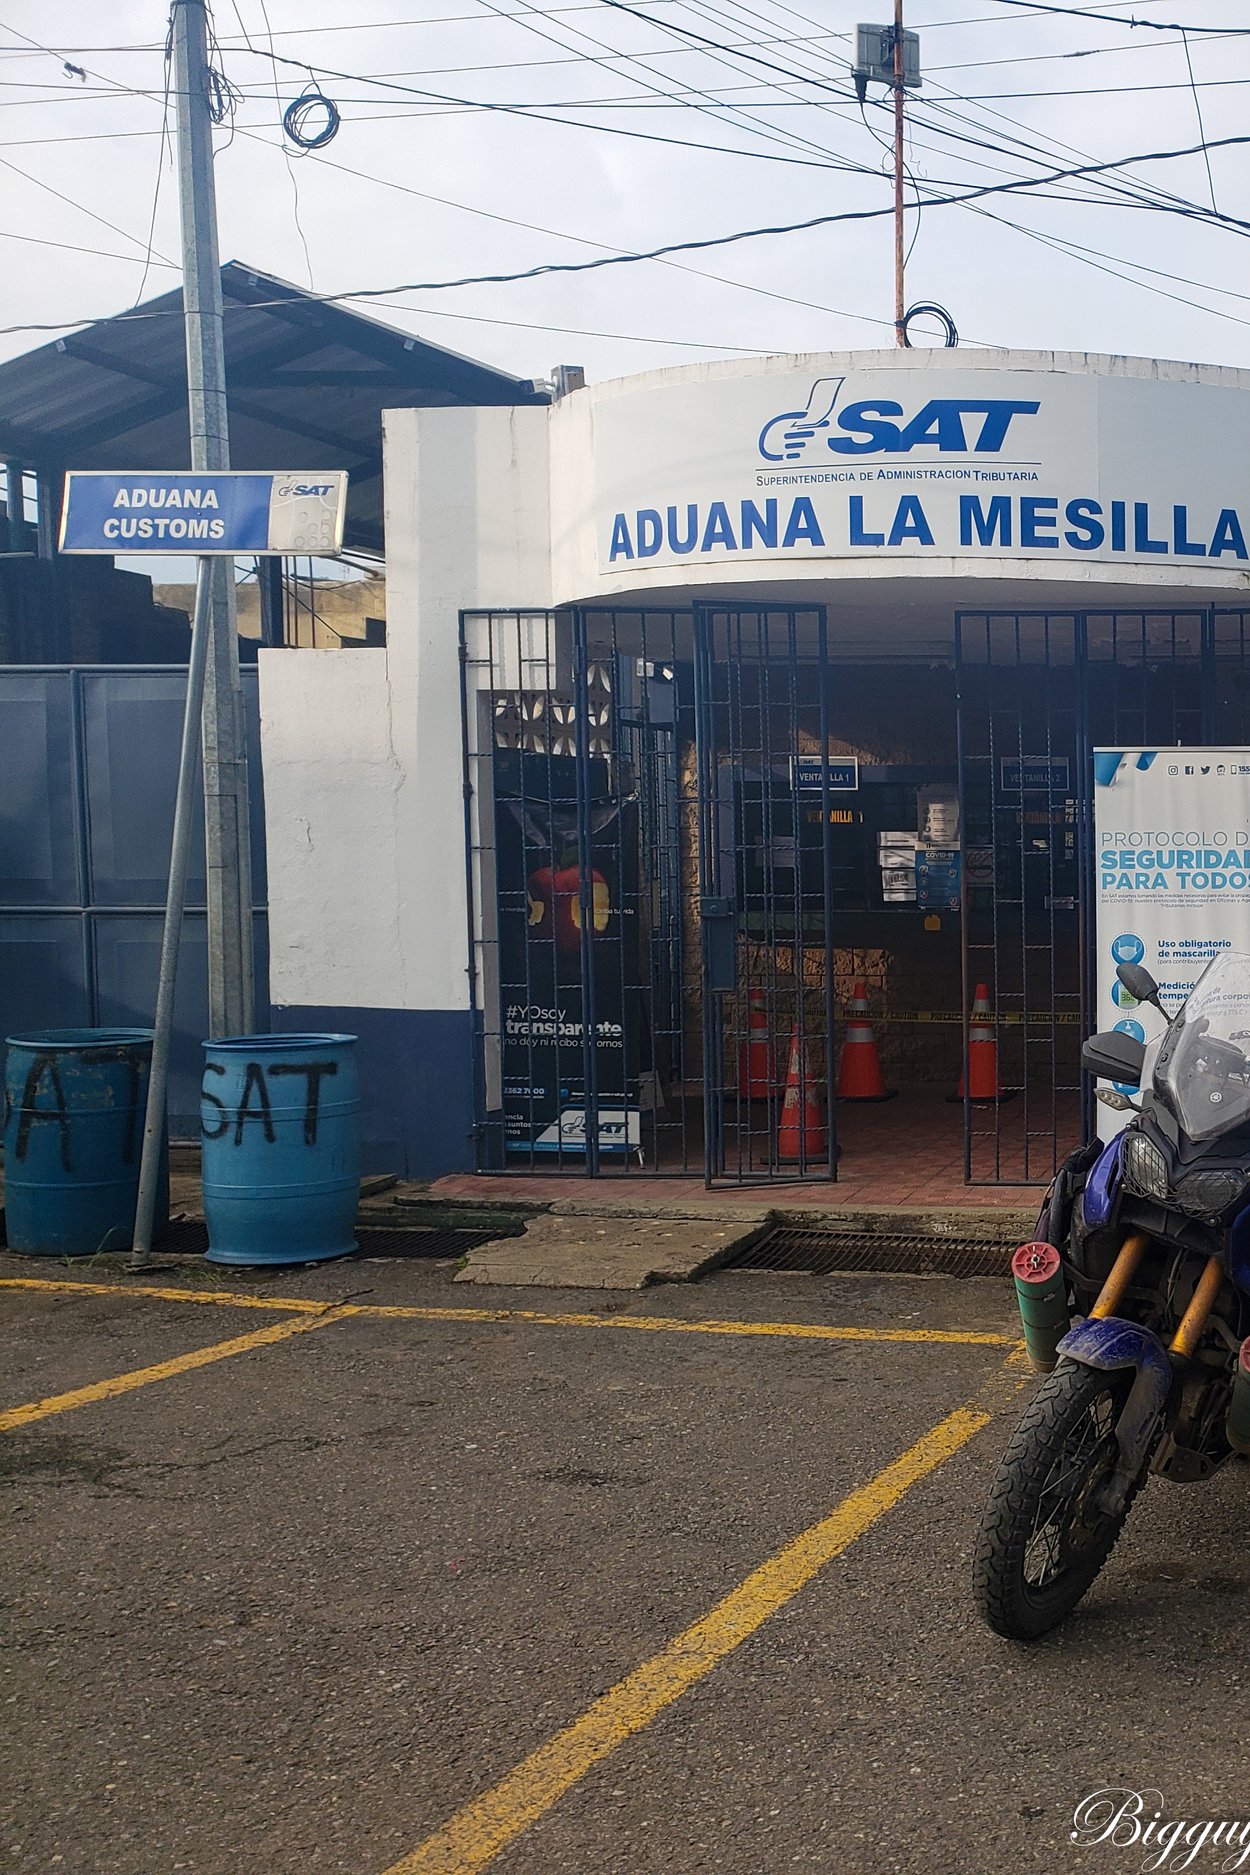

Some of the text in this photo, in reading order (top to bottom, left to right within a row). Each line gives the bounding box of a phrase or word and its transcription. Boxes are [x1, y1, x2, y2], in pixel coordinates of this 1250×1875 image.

[828, 400, 1040, 454] SAT
[756, 471, 855, 487] SUPERINTENDENCIA
[859, 471, 874, 482] DE
[973, 470, 1039, 482] TRIBUTARIA
[113, 488, 219, 509] ADUANA
[292, 485, 335, 496] SAT
[103, 518, 225, 539] CUSTOMS
[608, 495, 1249, 562] ADUANA LA MESILLA
[799, 773, 844, 782] VENTALLA
[1101, 831, 1228, 847] PROTOCOLO
[1102, 872, 1169, 890] PARA
[1158, 940, 1232, 949] Uso obligatorio
[1158, 981, 1196, 990] Medició
[3, 1048, 150, 1172] AT
[200, 1062, 338, 1146] SAT
